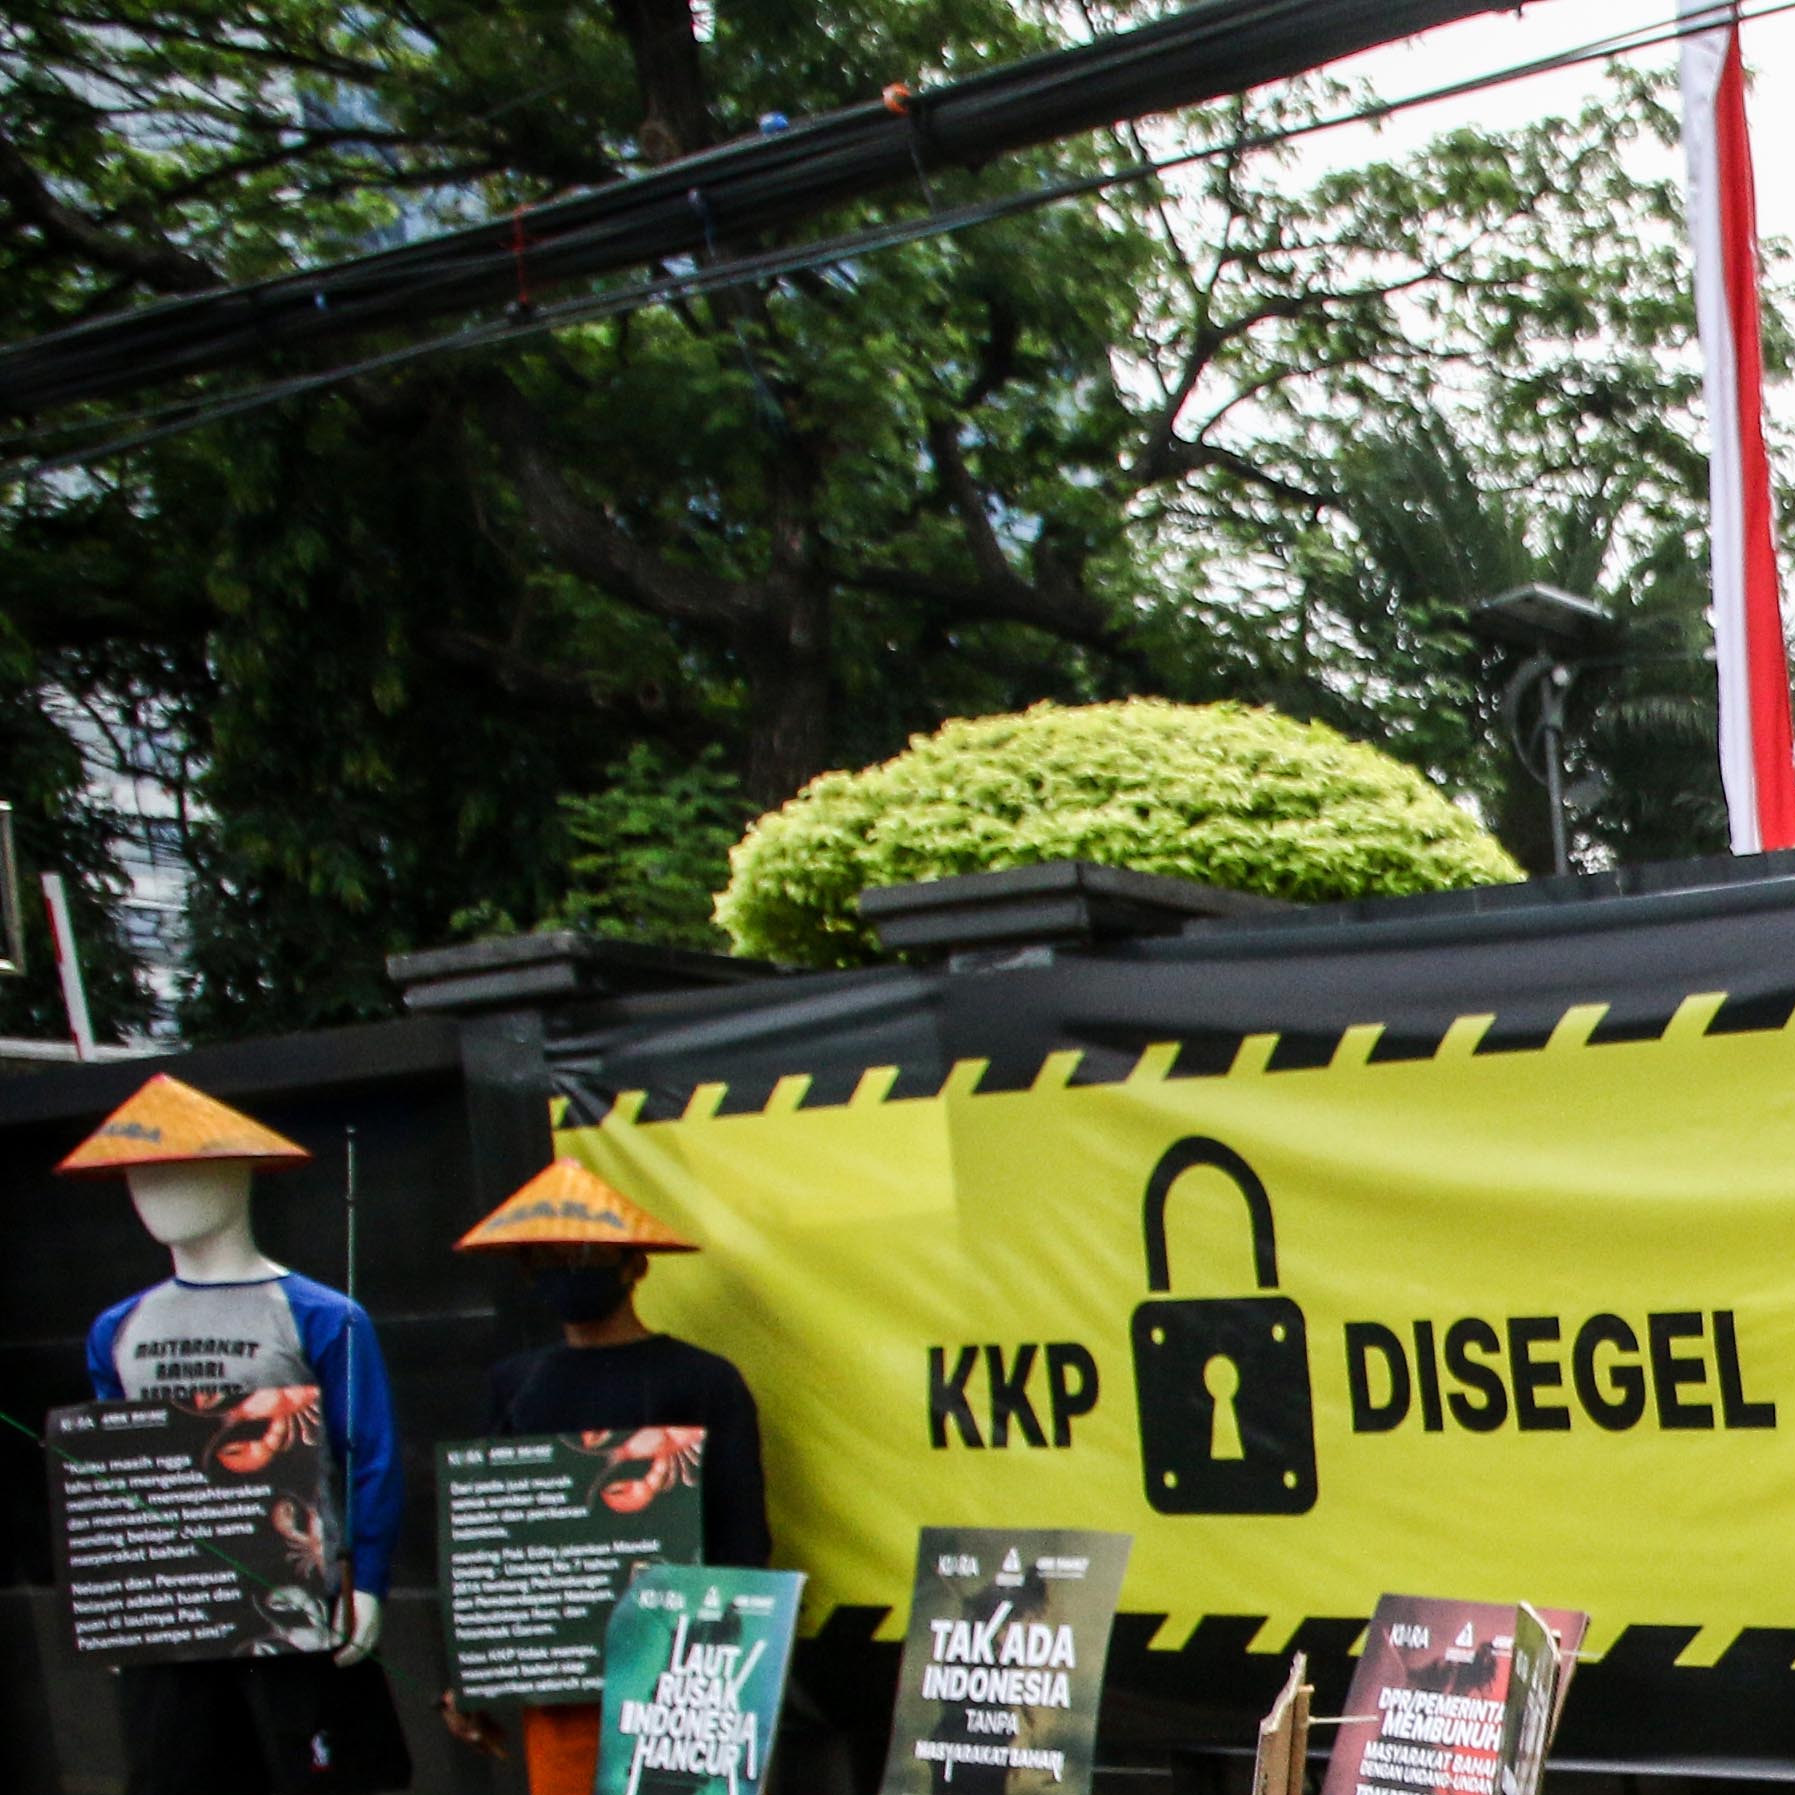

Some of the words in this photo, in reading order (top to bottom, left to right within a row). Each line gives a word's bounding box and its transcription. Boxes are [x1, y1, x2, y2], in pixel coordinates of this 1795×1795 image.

[927, 1341, 1100, 1449] KKP
[1343, 1309, 1777, 1434] DISEGEL
[670, 1613, 743, 1677] LAUT
[930, 1601, 1013, 1665] TAK
[1000, 1621, 1076, 1669] ADA
[656, 1640, 767, 1712] RUSAK
[921, 1665, 1071, 1708] INDONESIA
[619, 1699, 758, 1780] INDONESIA
[964, 1708, 1020, 1736] TANPA
[1381, 1710, 1502, 1752] MEMBUNUH
[914, 1739, 1008, 1782] MASYARAKAT
[1008, 1748, 1064, 1782] BAHARI
[1360, 1759, 1403, 1781] DENGAN
[1364, 1740, 1452, 1770] MASYARAKAT
